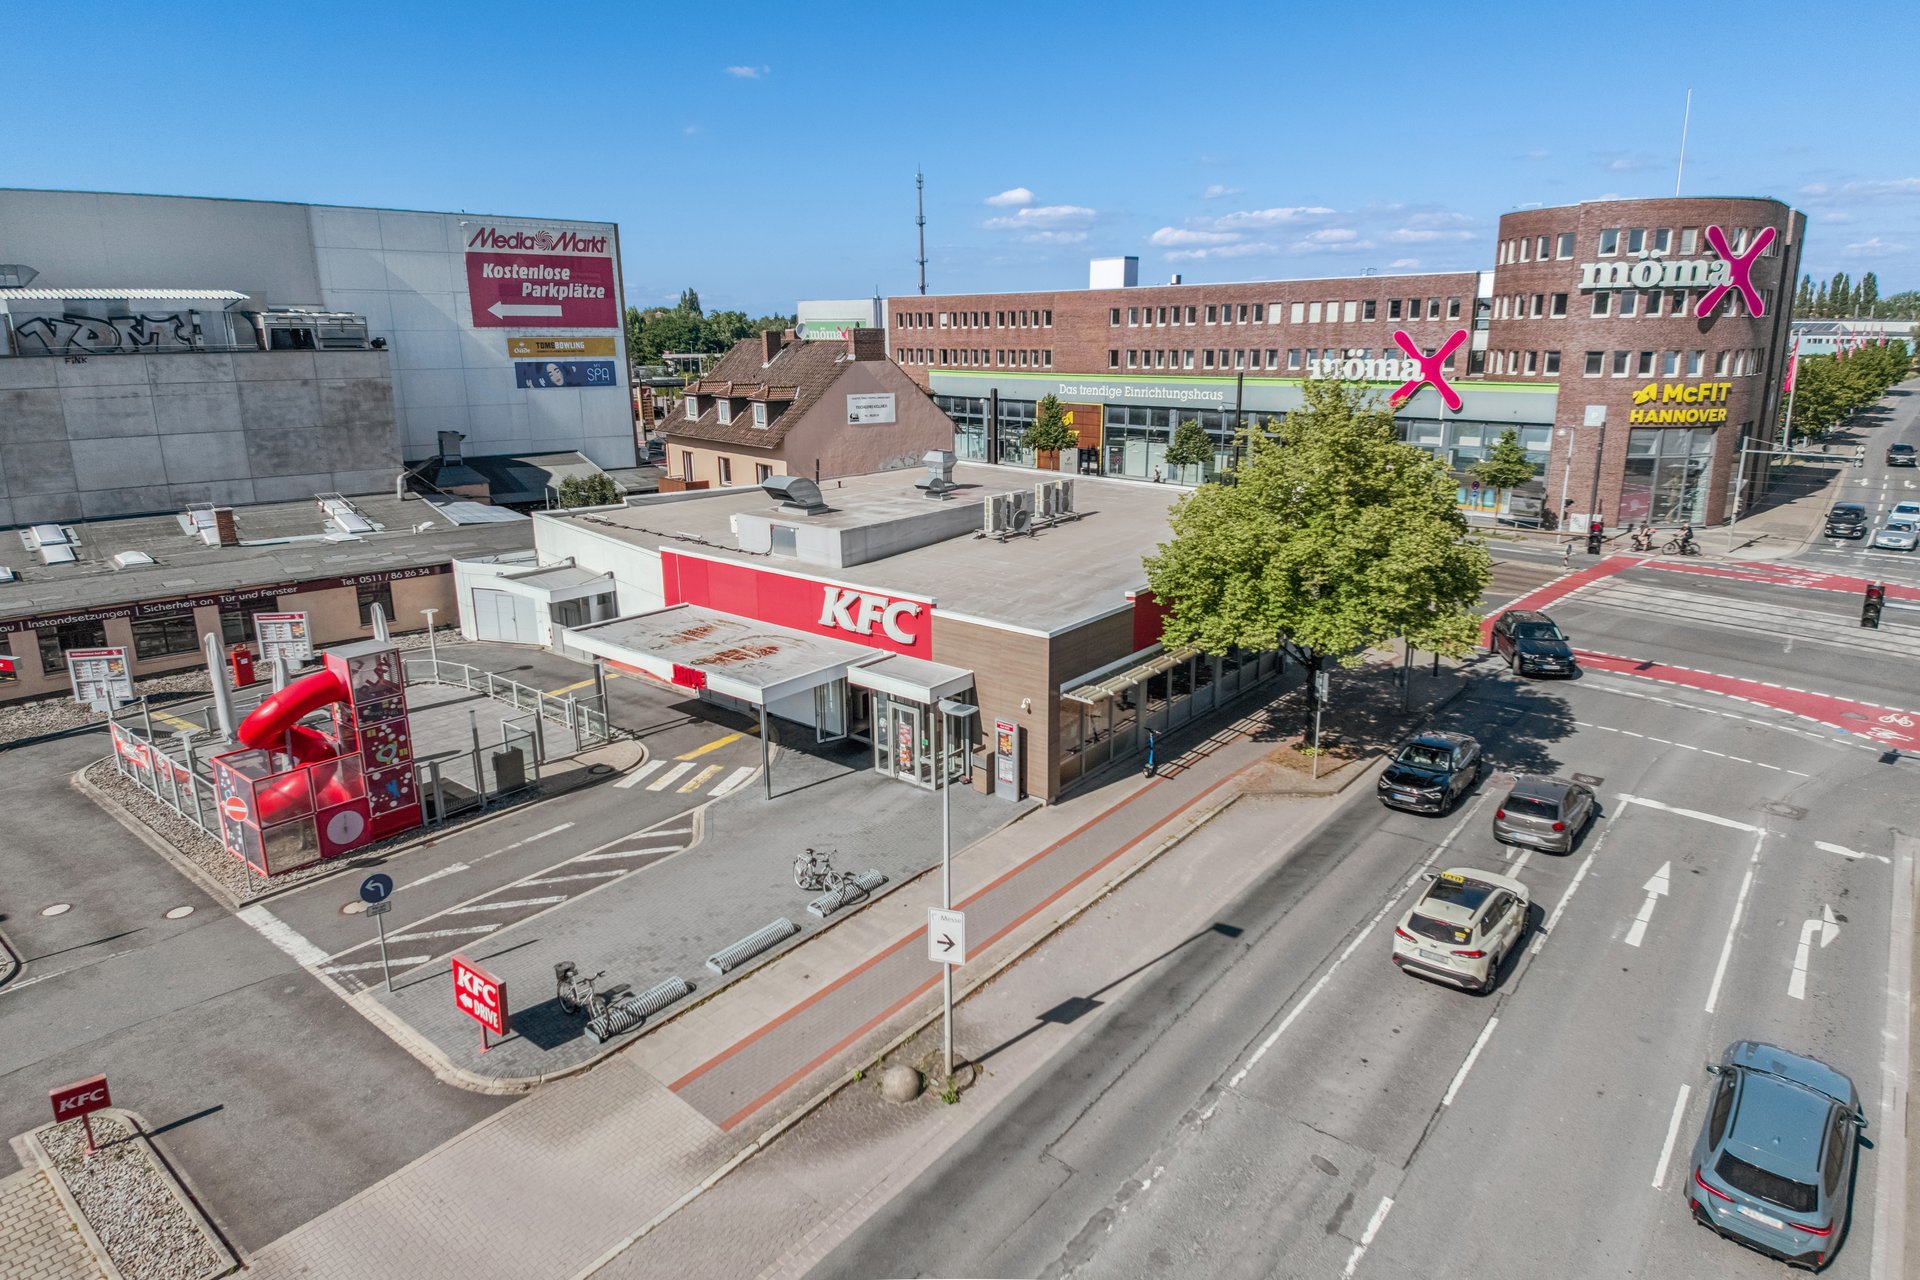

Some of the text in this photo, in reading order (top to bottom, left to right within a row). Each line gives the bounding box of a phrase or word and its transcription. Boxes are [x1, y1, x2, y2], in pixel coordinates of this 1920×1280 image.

[482, 263, 570, 280] Kostenlose
[522, 282, 605, 300] Parkplätze
[587, 367, 610, 382] SPA
[1059, 384, 1224, 402] Das trendige Einrichtungshaus
[1662, 383, 1732, 403] McFIT
[1629, 408, 1727, 424] HANNOVER
[341, 578, 357, 586] Tel.
[359, 574, 382, 584] 0511
[391, 572, 403, 580] 86
[405, 570, 416, 578] 26
[418, 568, 430, 576] 34
[143, 586, 298, 614] Sicherheit an Tür und Fenster
[28, 608, 131, 629] Instandsetzungen
[818, 586, 922, 645] KFC
[457, 966, 497, 1007] KFC
[473, 999, 499, 1029] DRIVE
[59, 1088, 105, 1113] KFC
